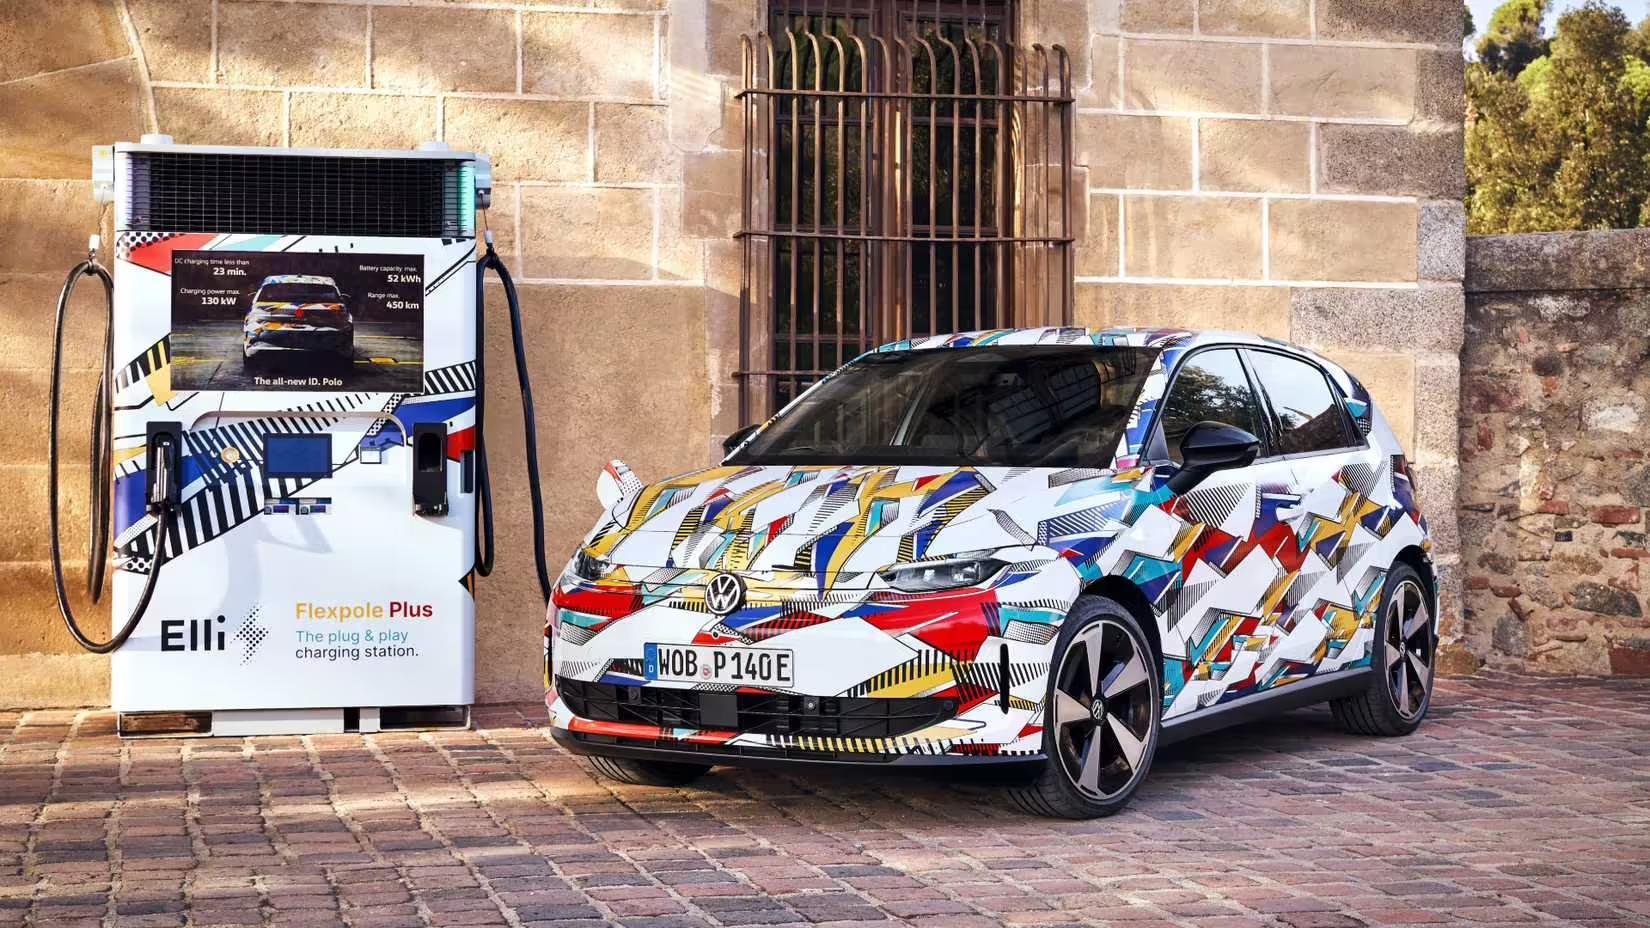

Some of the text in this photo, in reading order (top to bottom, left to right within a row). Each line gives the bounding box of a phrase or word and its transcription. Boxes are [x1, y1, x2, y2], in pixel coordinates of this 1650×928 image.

[184, 258, 209, 266] charging
[213, 267, 247, 276] 23 min.
[380, 265, 402, 273] capacity
[387, 274, 421, 283] 52 kWh
[180, 288, 207, 296] Charging
[367, 292, 386, 300] Range
[201, 297, 237, 305] 130 kW
[386, 301, 419, 309] 450 km
[254, 376, 343, 386] The all-new ID. Polo
[295, 601, 433, 622] Flexpole Plus
[161, 615, 226, 652] Elli
[295, 629, 409, 646] The plug & play
[295, 645, 419, 662] charging station.
[658, 648, 698, 677] WOB
